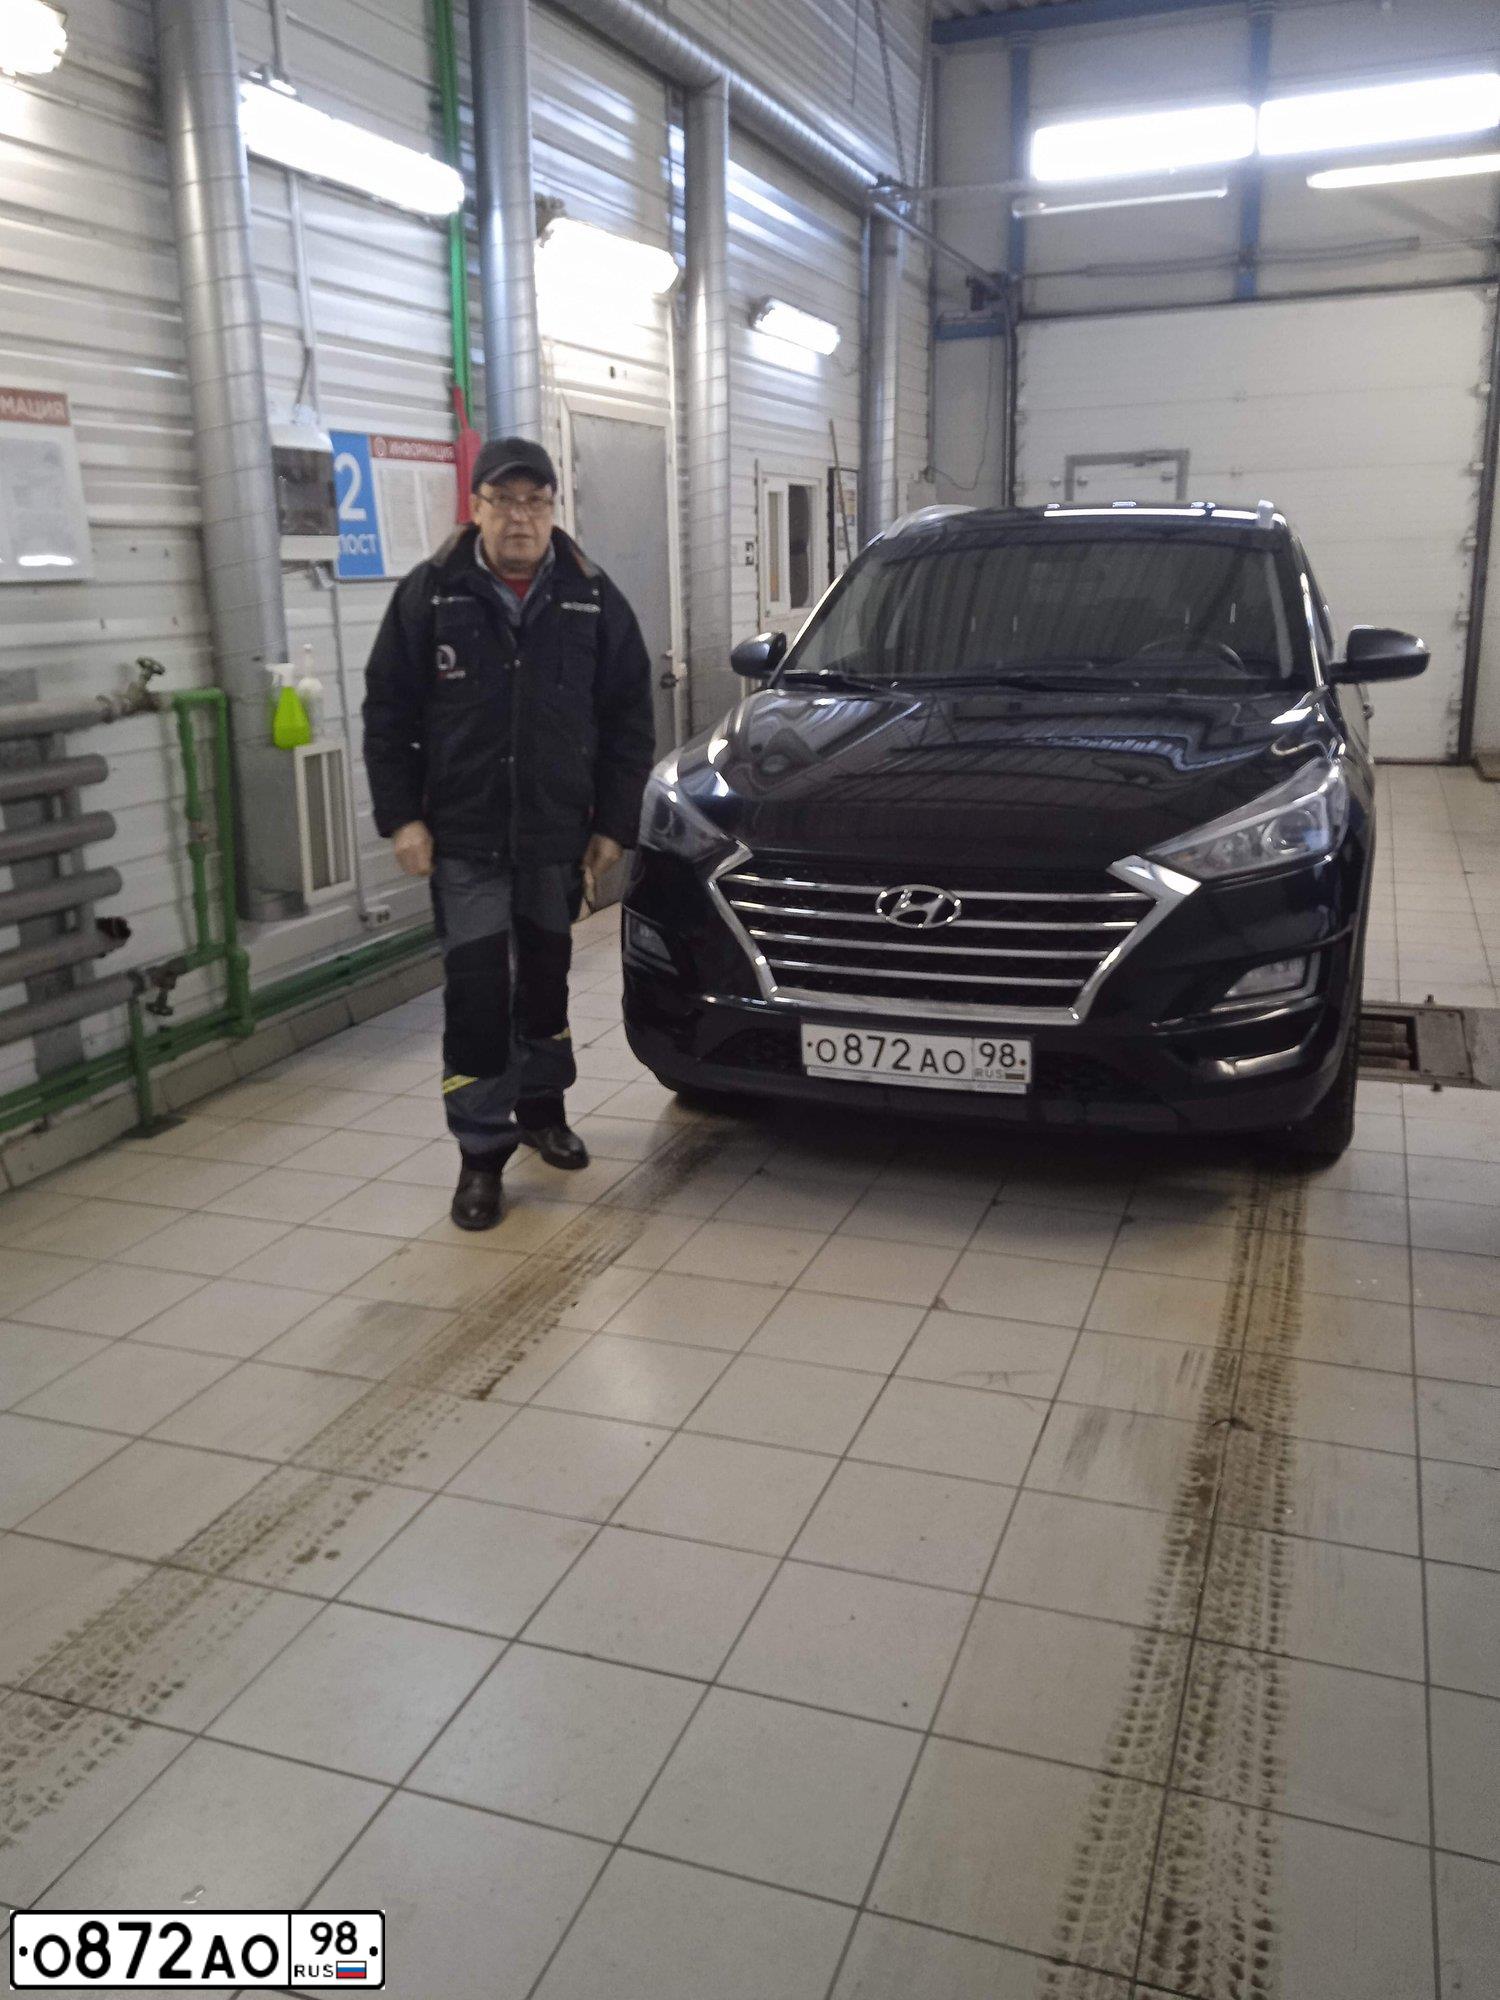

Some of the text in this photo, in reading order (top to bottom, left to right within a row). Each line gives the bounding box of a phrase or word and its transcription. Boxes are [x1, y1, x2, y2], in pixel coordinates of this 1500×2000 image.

[334, 452, 366, 520] 2
[980, 1043, 1015, 1067] 98
[974, 1068, 1003, 1079] RUS
